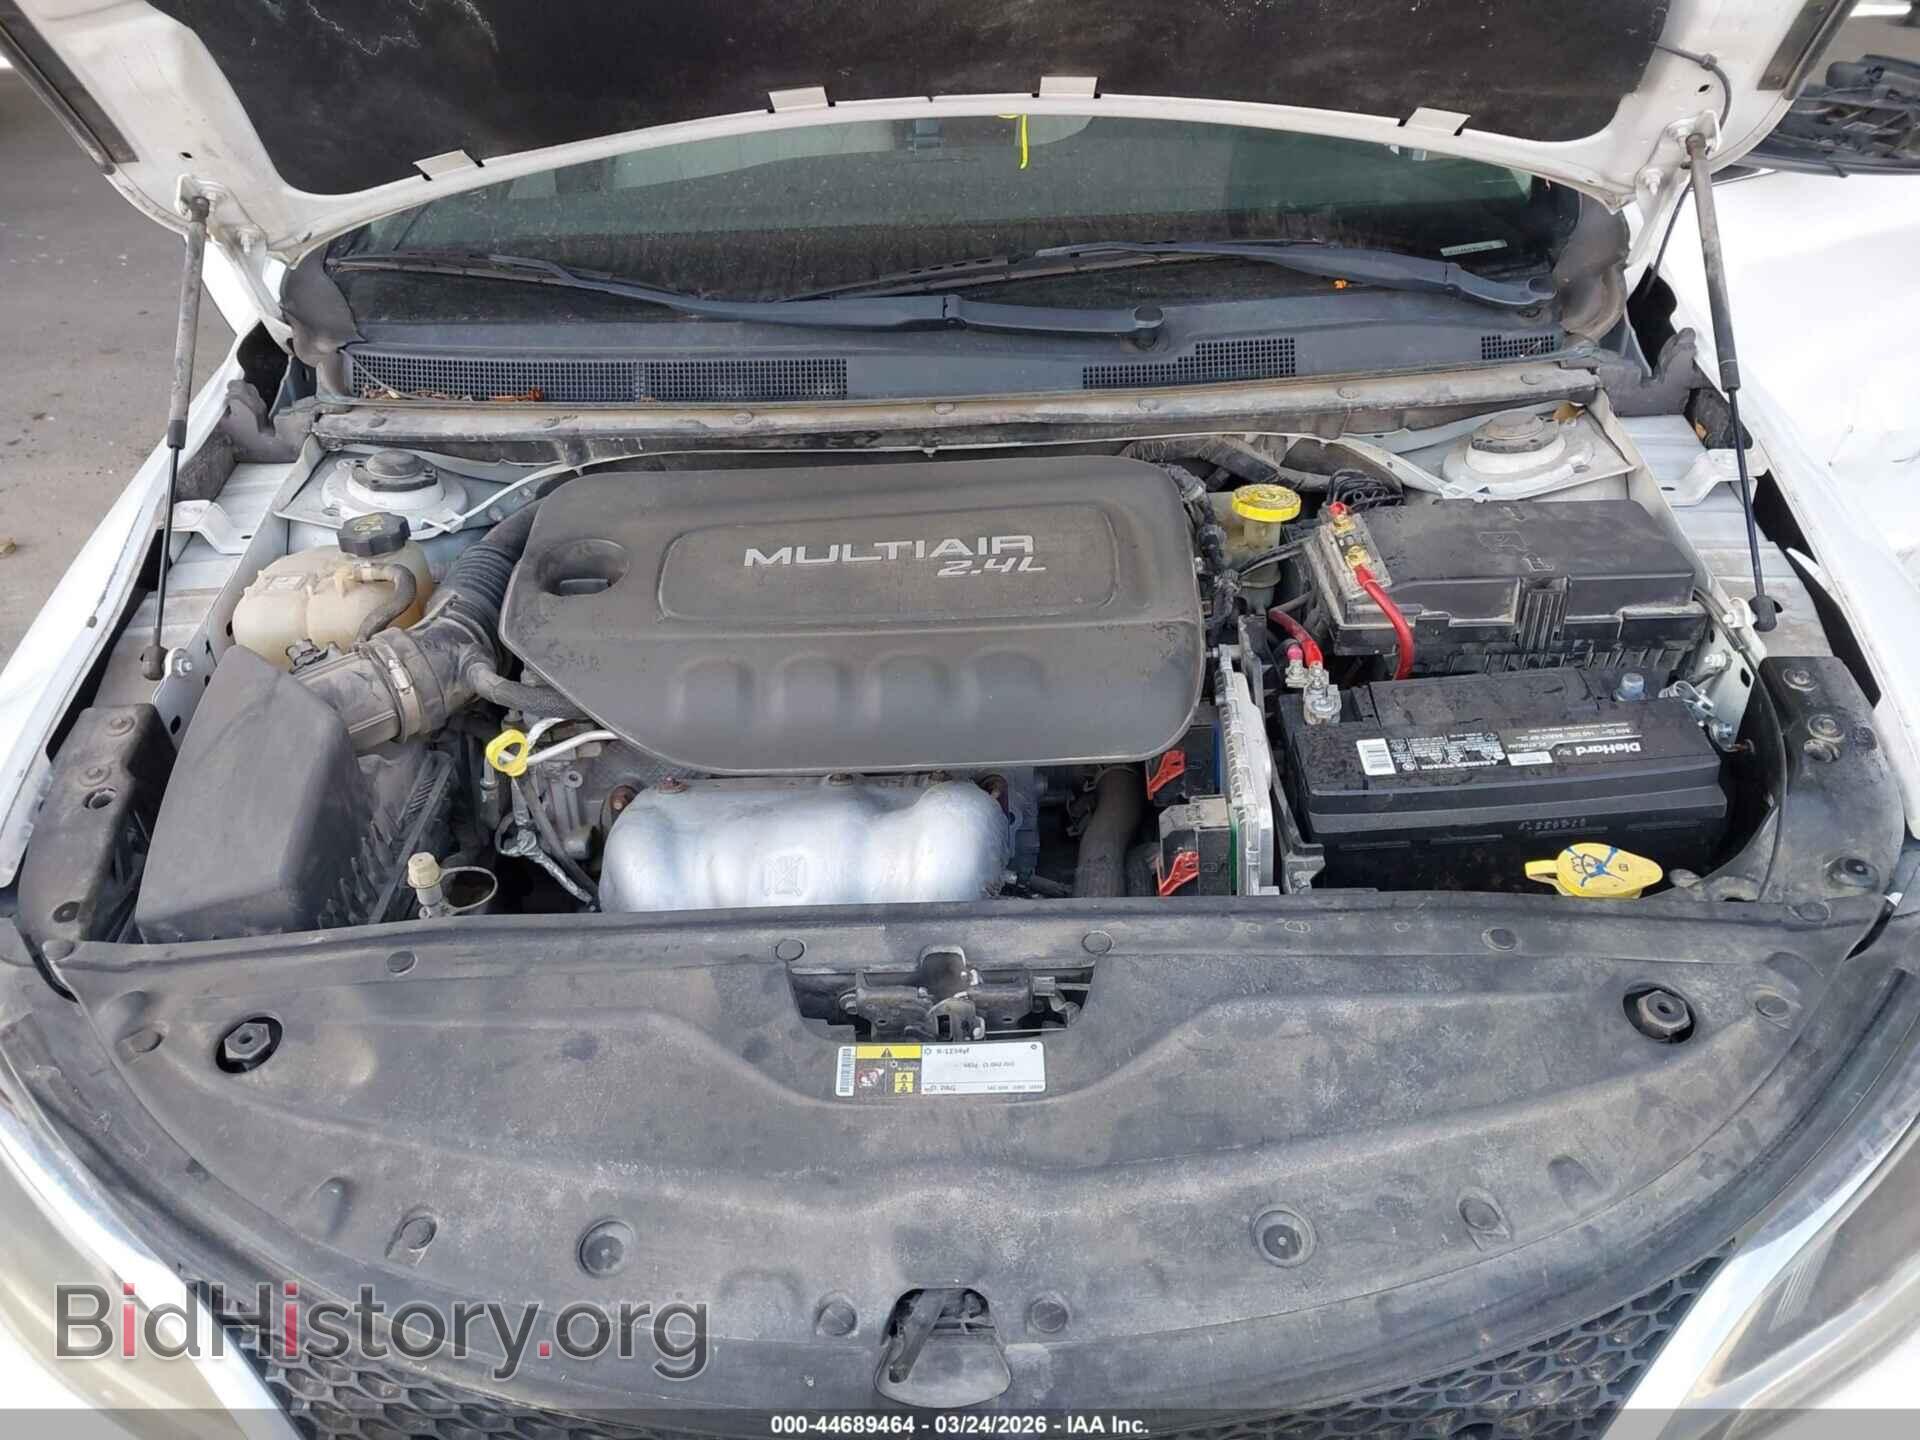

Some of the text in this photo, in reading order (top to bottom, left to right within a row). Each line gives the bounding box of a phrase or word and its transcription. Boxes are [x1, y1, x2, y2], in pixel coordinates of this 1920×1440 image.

[743, 534, 1035, 567] MULTIAIR
[936, 556, 1047, 577] 2.4L
[1575, 742, 1642, 756] DieHard
